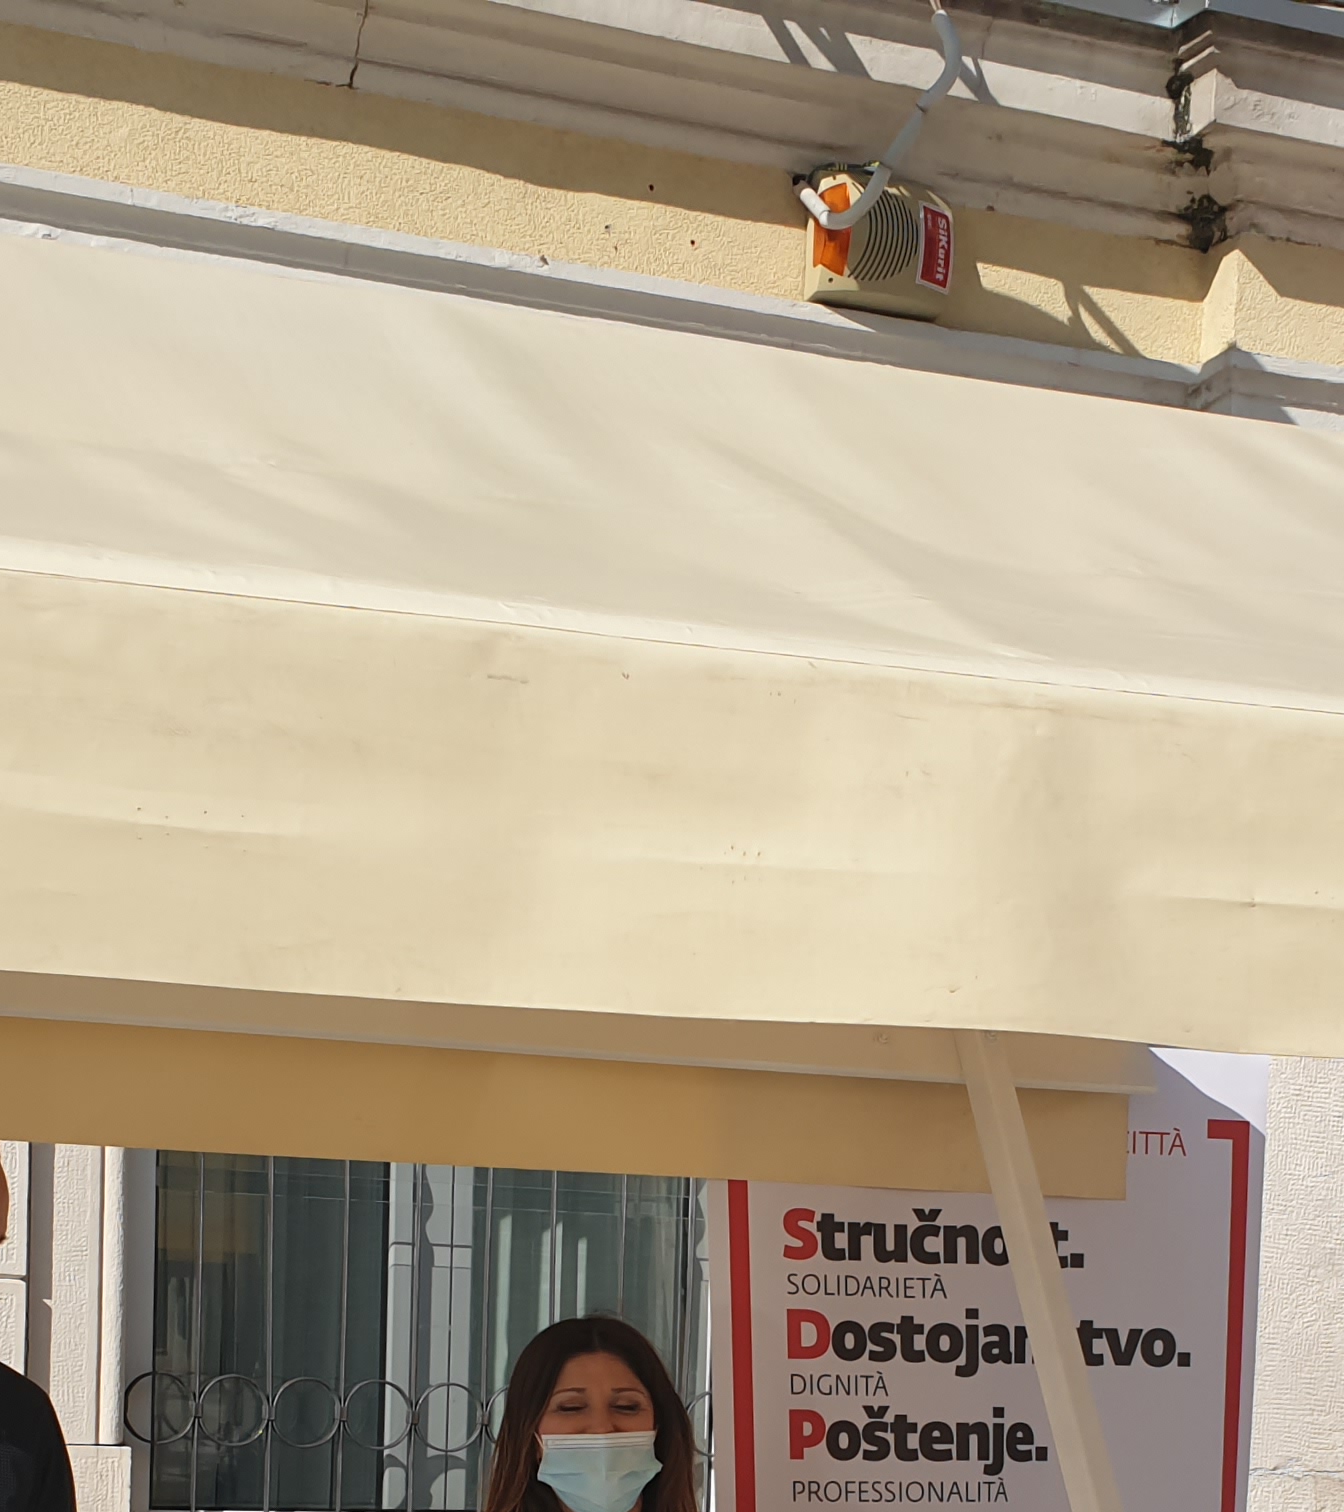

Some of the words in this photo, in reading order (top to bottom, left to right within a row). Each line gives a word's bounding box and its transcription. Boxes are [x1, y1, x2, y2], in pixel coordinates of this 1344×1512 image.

[1127, 1128, 1187, 1157] ITTÀ
[782, 1207, 1085, 1269] Stručnot.
[787, 1273, 947, 1299] SOLIDARIETÀ
[790, 1370, 889, 1397] DIGNITÀ
[788, 1405, 1048, 1476] Poštenje.
[792, 1477, 1008, 1503] PROFESSIONALITÀ
